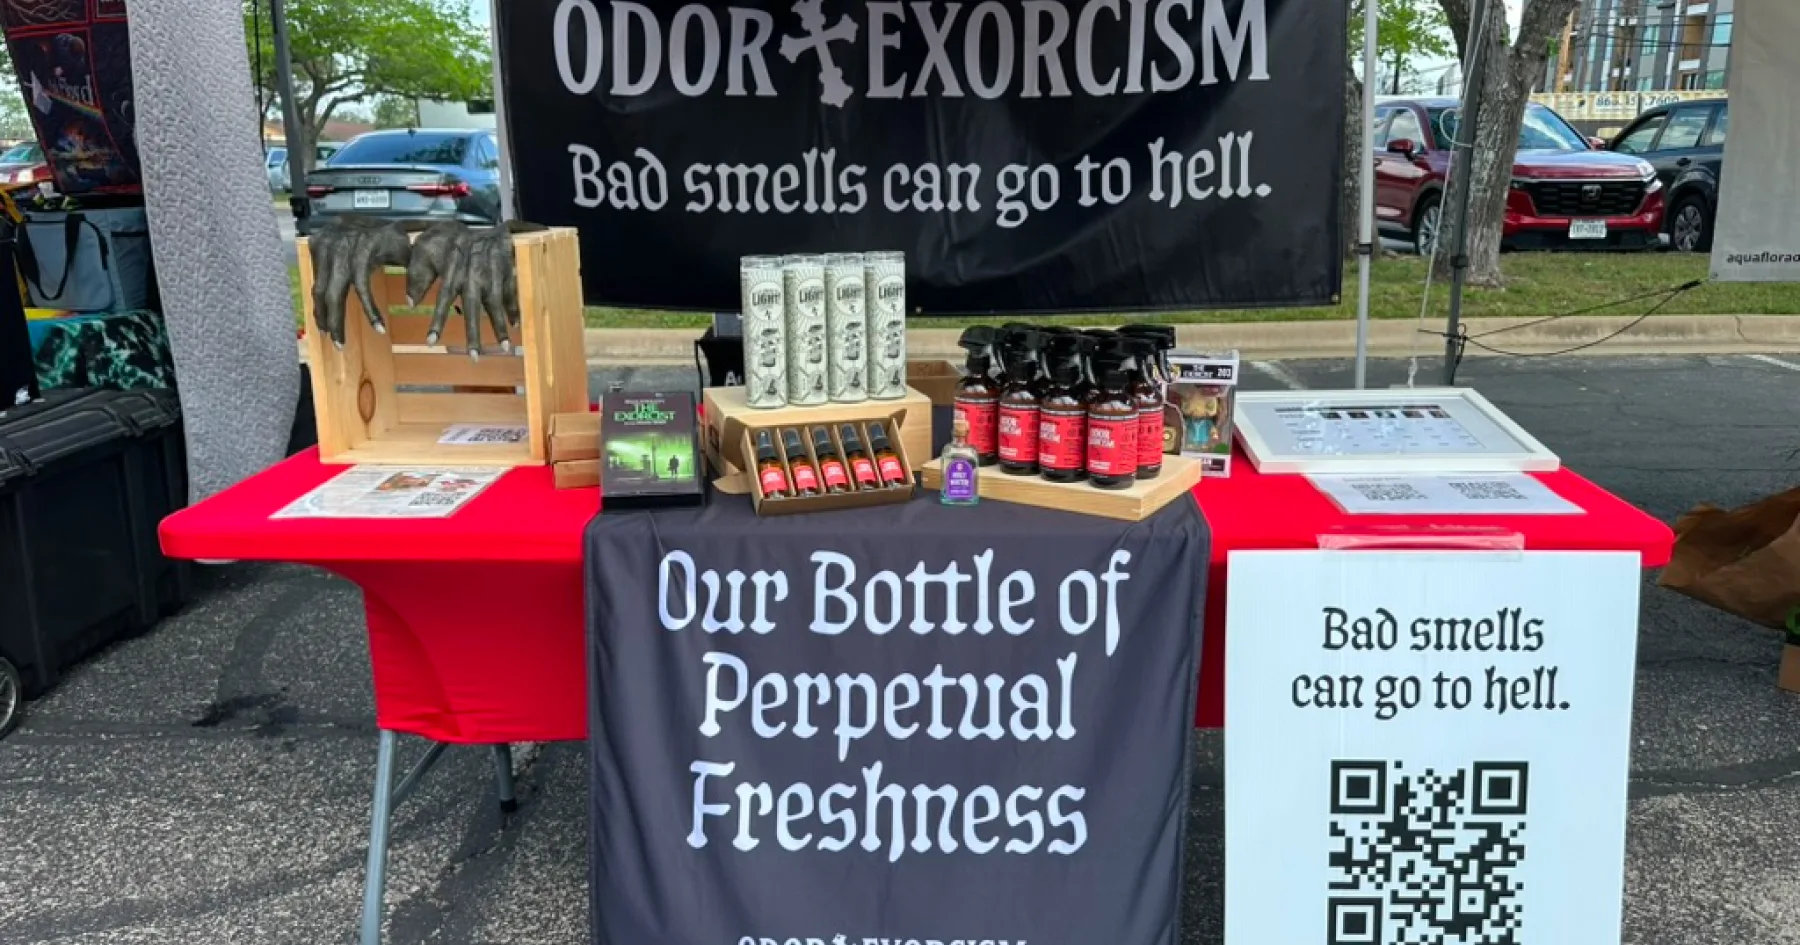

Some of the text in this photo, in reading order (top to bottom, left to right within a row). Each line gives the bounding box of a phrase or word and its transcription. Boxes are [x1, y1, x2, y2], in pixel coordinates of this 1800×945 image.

[553, 0, 1270, 99] ODOR EXORCISM
[568, 131, 1272, 229] Bad smells can go to hell.
[658, 547, 1132, 658] Our Bottle of
[1321, 606, 1545, 652] Bad smells
[698, 651, 1078, 762] Perpetual
[1291, 665, 1571, 721] can go to hell.
[686, 760, 1089, 863] Freshness
